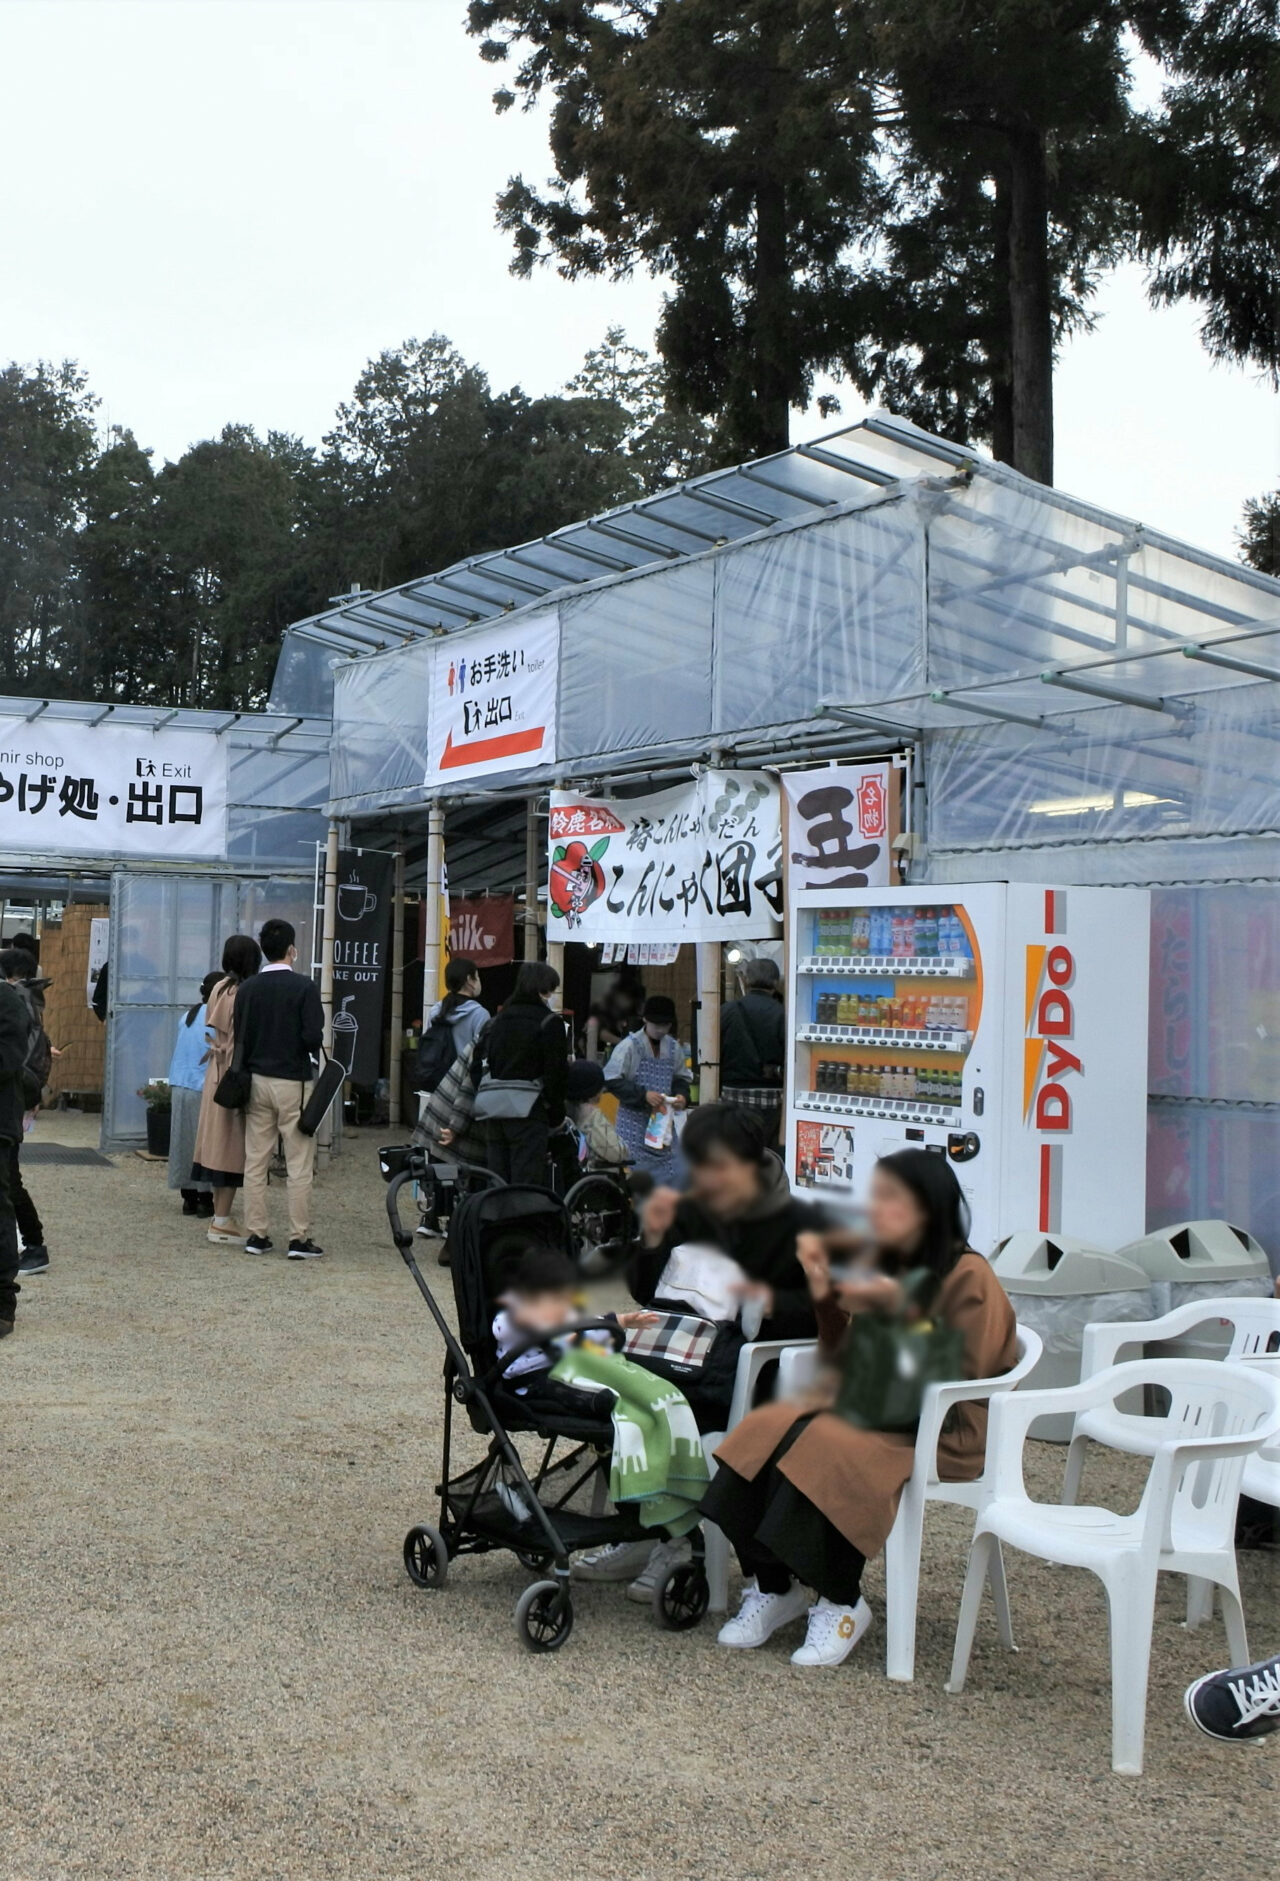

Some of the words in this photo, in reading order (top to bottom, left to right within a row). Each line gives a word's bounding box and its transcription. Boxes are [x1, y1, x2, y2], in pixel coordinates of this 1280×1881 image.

[470, 649, 525, 687] お手洗い
[527, 659, 545, 673] toilet
[484, 695, 512, 728] 出口
[25, 749, 65, 770] shop
[161, 763, 192, 779] Exit
[334, 939, 379, 965] OFFEE
[354, 971, 379, 982] OUT
[1035, 945, 1082, 1131] DyDo
